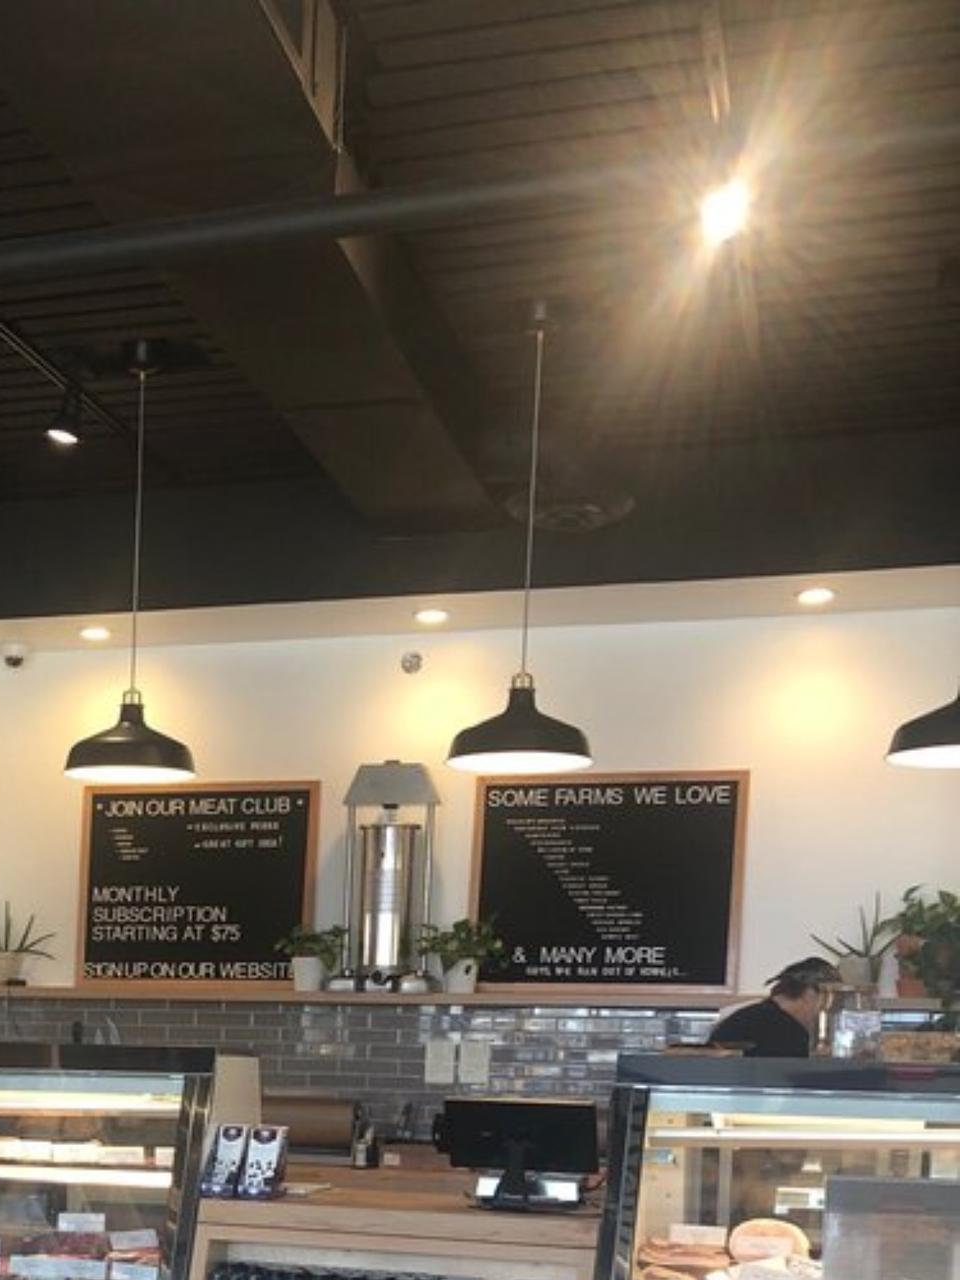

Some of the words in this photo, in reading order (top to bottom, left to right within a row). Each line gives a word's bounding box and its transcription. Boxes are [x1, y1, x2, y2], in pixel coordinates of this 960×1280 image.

[488, 788, 550, 808] SOME
[555, 787, 623, 806] FARMS
[634, 786, 667, 805] WE
[675, 785, 732, 805] LOVE
[105, 801, 142, 817] JOIN
[145, 801, 185, 816] OUR
[190, 799, 237, 815] MEAT
[242, 797, 291, 815] CLUB
[92, 885, 180, 902] MONTHLY
[92, 906, 228, 923] SUBSCRIPTION
[91, 924, 178, 942] STARTING
[183, 924, 206, 941] AT
[211, 923, 241, 943] $75
[512, 946, 527, 963] &
[540, 946, 597, 964] MANY
[604, 946, 666, 965] MORE
[84, 961, 123, 978] SIGN
[124, 962, 150, 978] UP
[150, 961, 177, 978] ON
[178, 961, 215, 979] OUR
